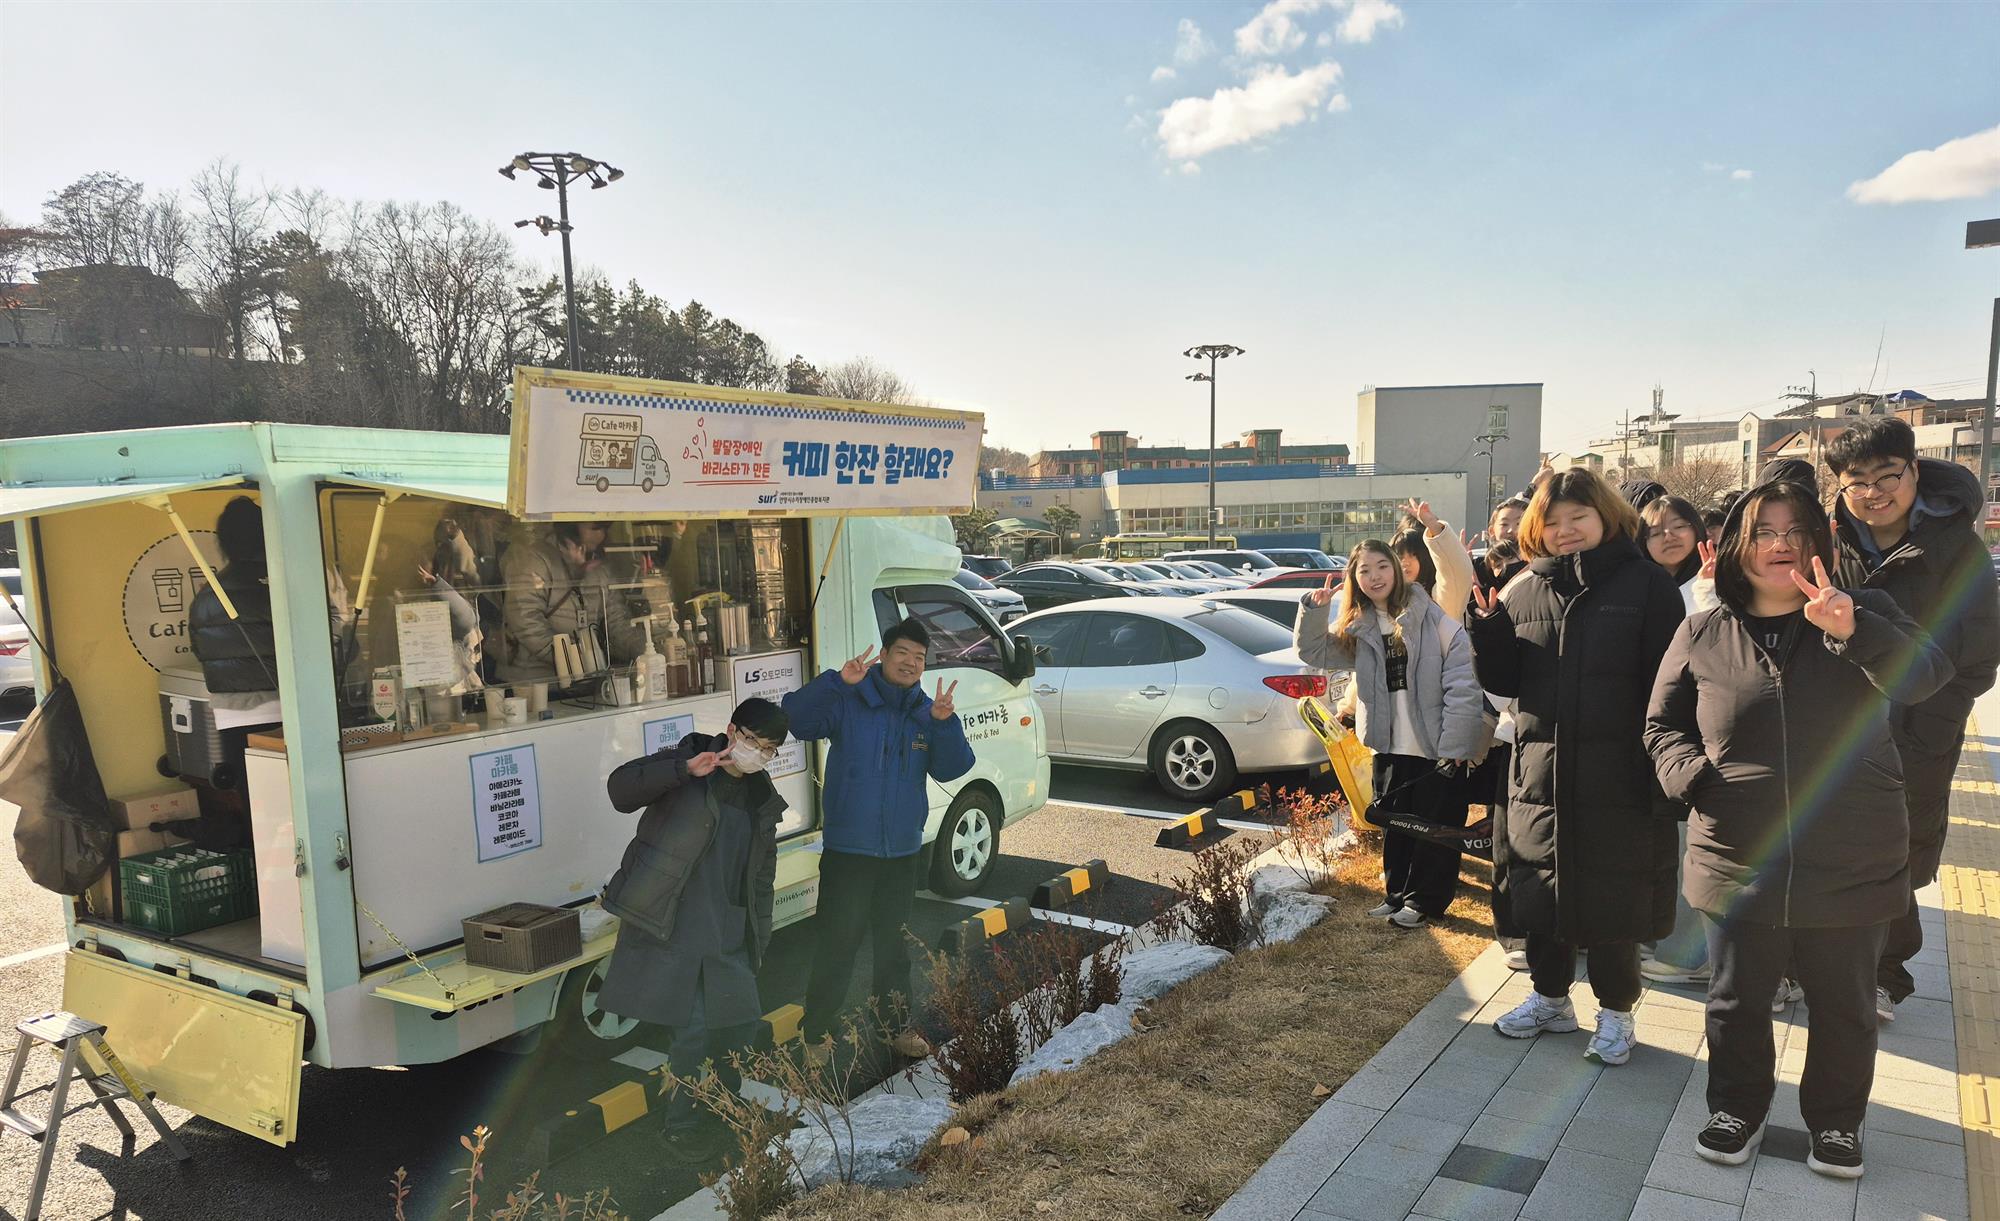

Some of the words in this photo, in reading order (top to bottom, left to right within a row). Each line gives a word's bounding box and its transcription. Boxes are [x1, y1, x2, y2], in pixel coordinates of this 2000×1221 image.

[601, 420, 617, 430] Cafe
[618, 421, 638, 432] 마카롱
[712, 439, 763, 456] 발달장애인
[702, 461, 750, 475] 바리스타가
[753, 463, 770, 478] 만든
[782, 441, 831, 477] 커피
[835, 440, 880, 484] 한잔
[884, 443, 954, 485] 할래요?
[149, 620, 187, 638] Caf
[744, 670, 760, 684] LS
[761, 667, 793, 681] 오토모티브
[963, 713, 975, 730] fe
[977, 704, 1009, 725] 마카롱
[662, 722, 677, 733] 카페
[965, 732, 982, 743] offee
[495, 753, 514, 767] 카페
[491, 763, 519, 778] 마카롱
[489, 777, 523, 791] 아메리카노
[493, 788, 521, 801] 카페라떼
[490, 798, 525, 813] 바닐라라떼
[498, 810, 519, 822] 코코아
[498, 820, 519, 832] 레몬차
[493, 829, 526, 845] 레몬에이드
